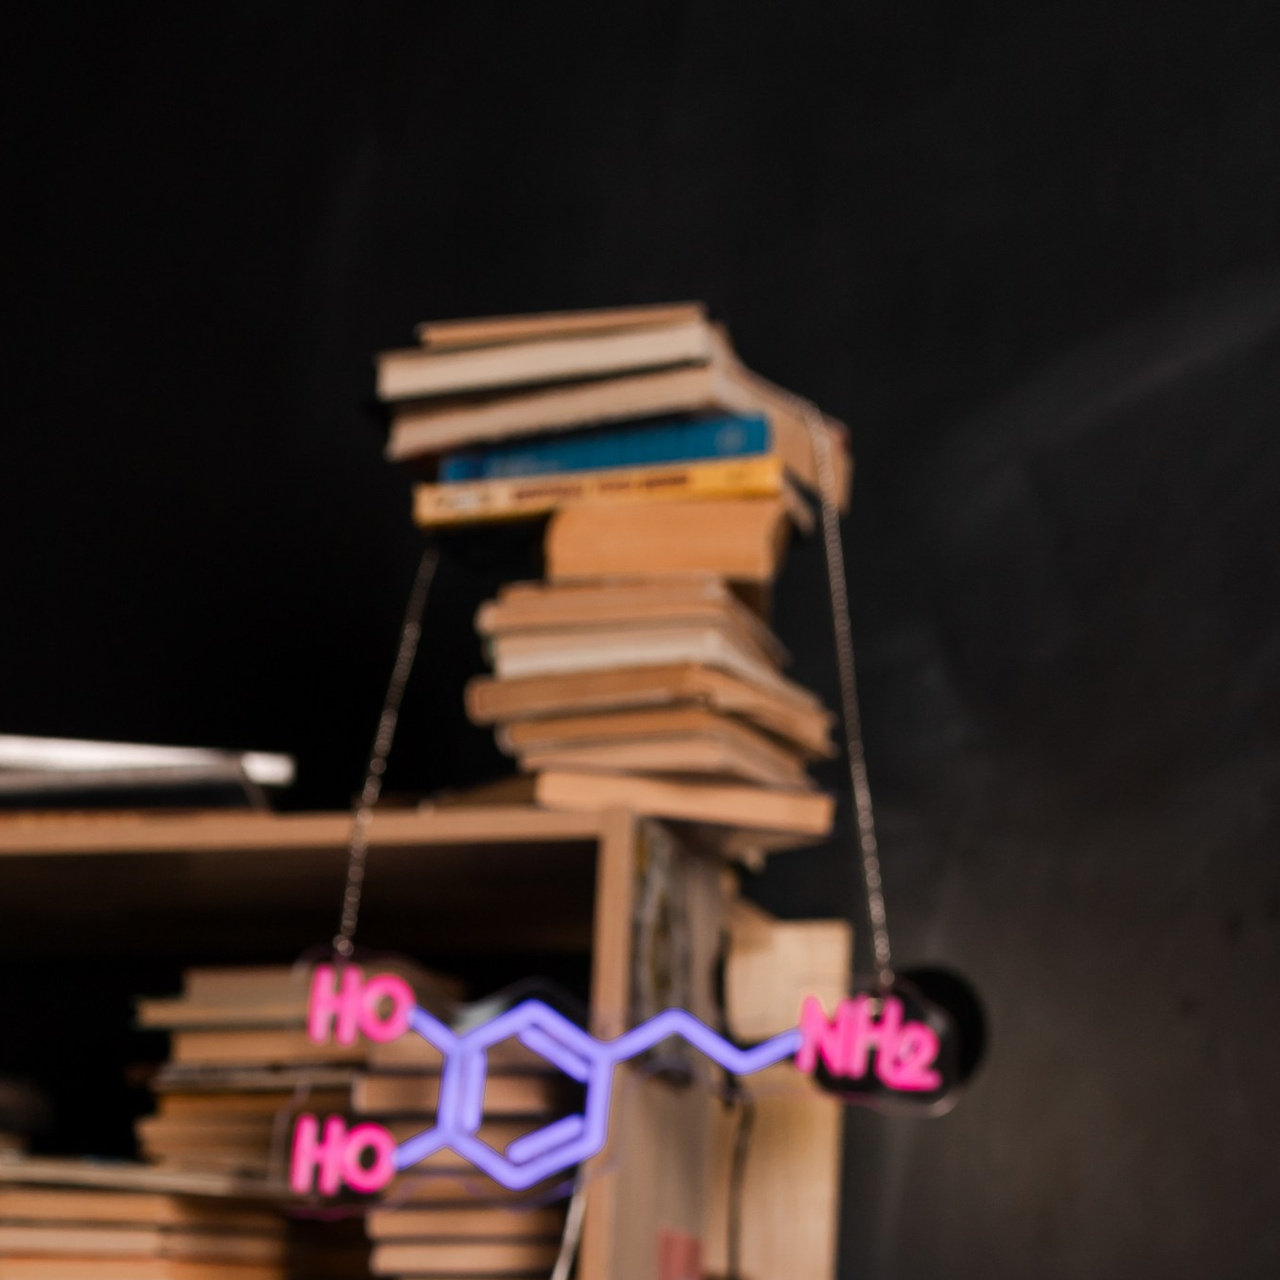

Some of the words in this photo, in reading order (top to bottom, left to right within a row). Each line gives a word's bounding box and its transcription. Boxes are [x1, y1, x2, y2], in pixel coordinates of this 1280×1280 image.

[307, 963, 416, 1046] HO
[794, 993, 942, 1091] NH2
[289, 1112, 398, 1196] HO
